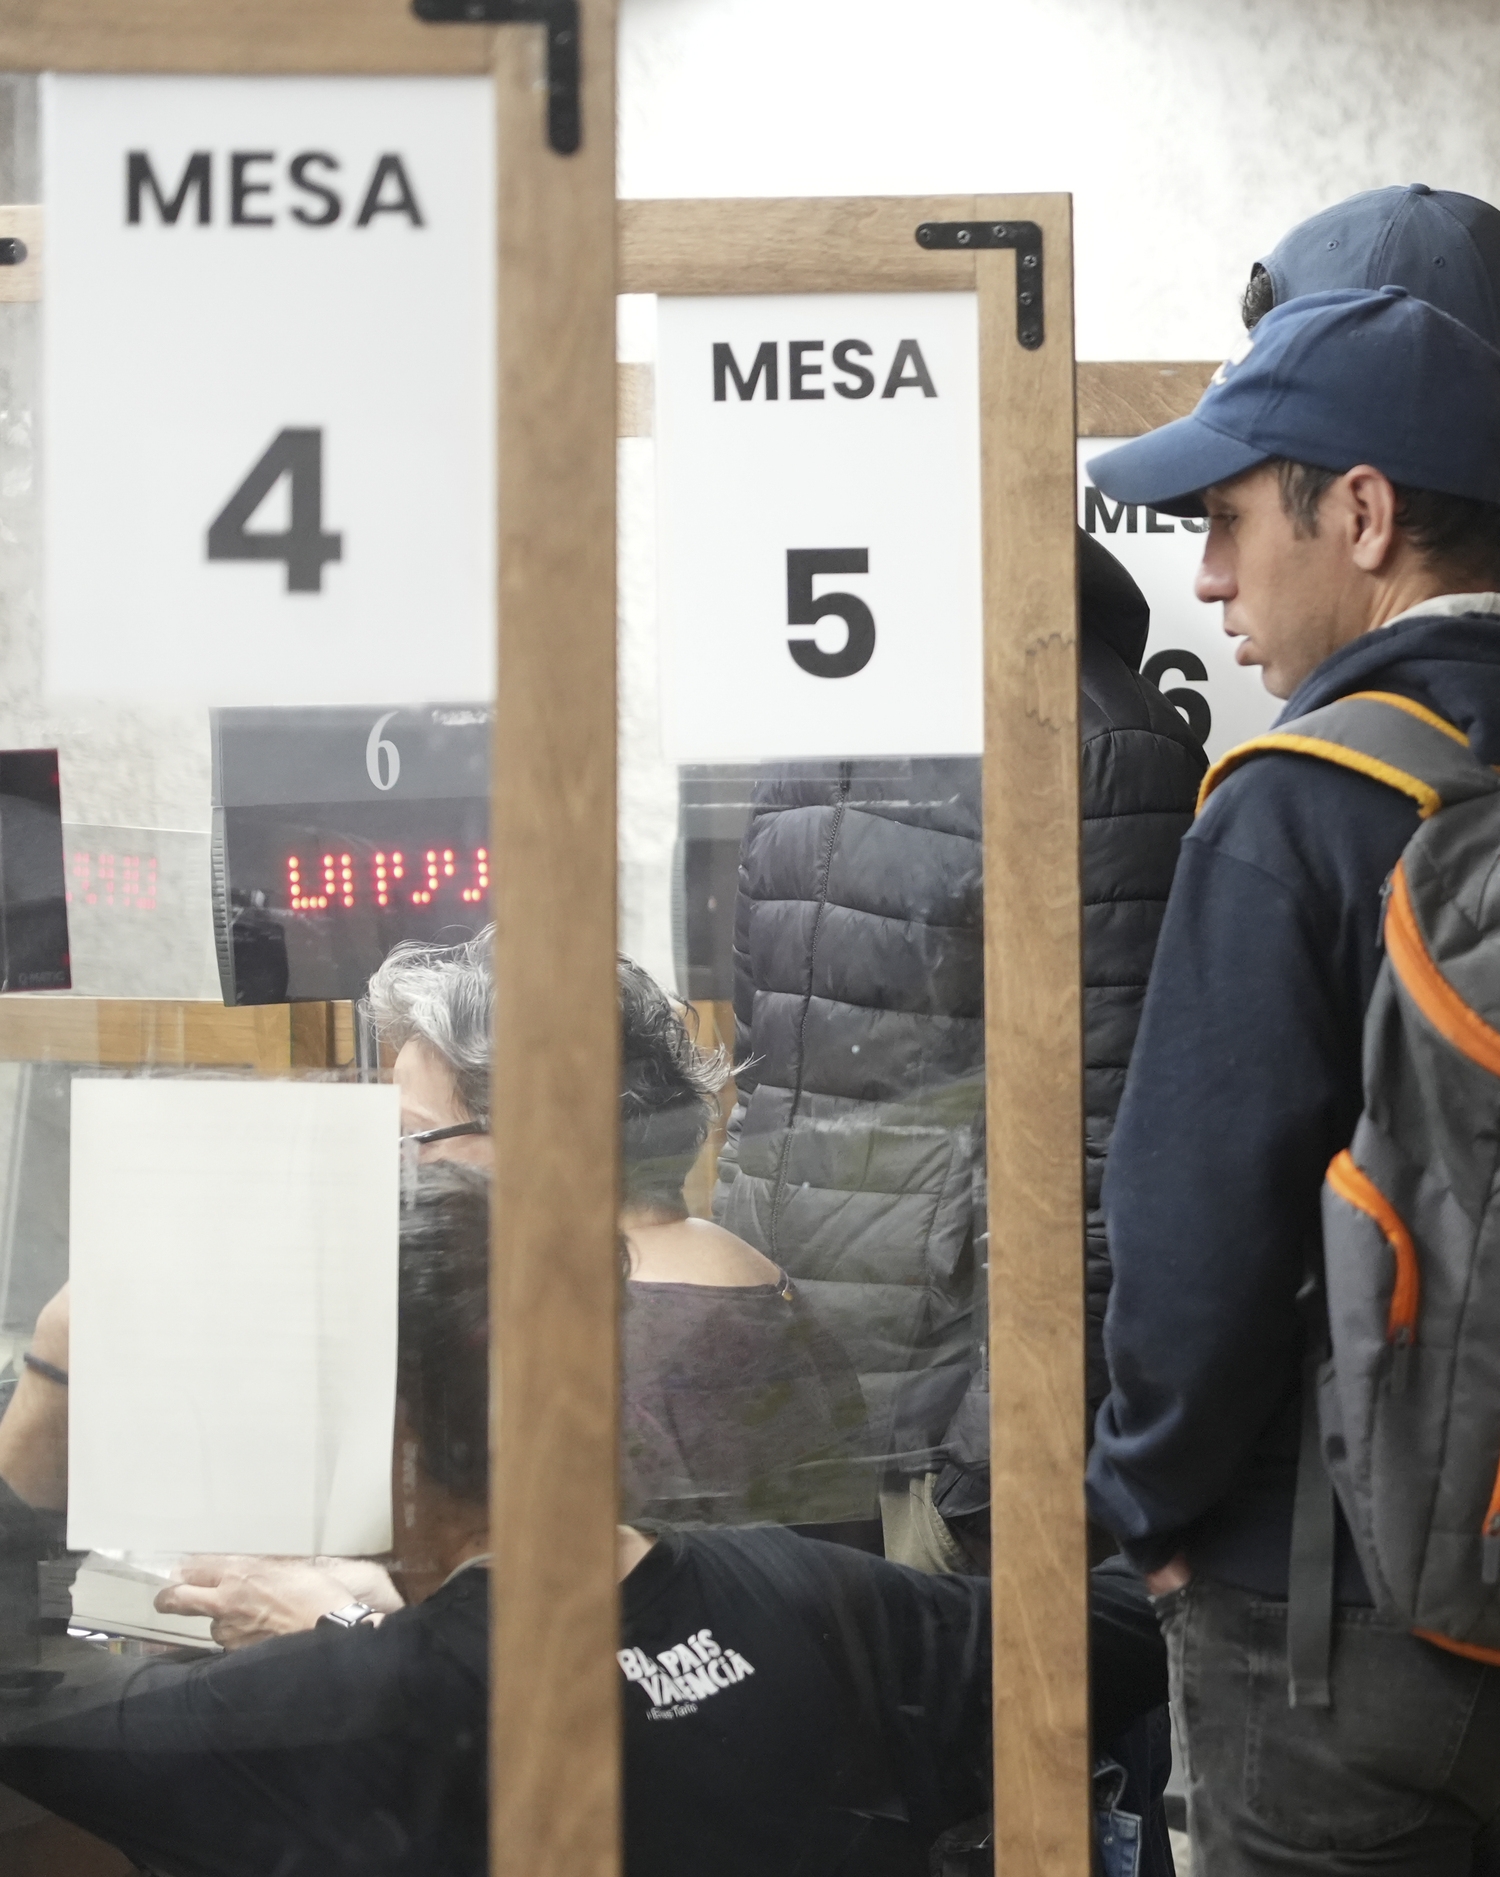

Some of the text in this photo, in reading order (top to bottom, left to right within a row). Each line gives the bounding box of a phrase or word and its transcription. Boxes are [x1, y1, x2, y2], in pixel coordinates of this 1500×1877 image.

[126, 151, 424, 228] MESA
[712, 338, 938, 402] MESA
[206, 427, 343, 594] 4
[786, 547, 876, 679] 5
[1140, 648, 1212, 747] 6
[365, 710, 401, 791] 6
